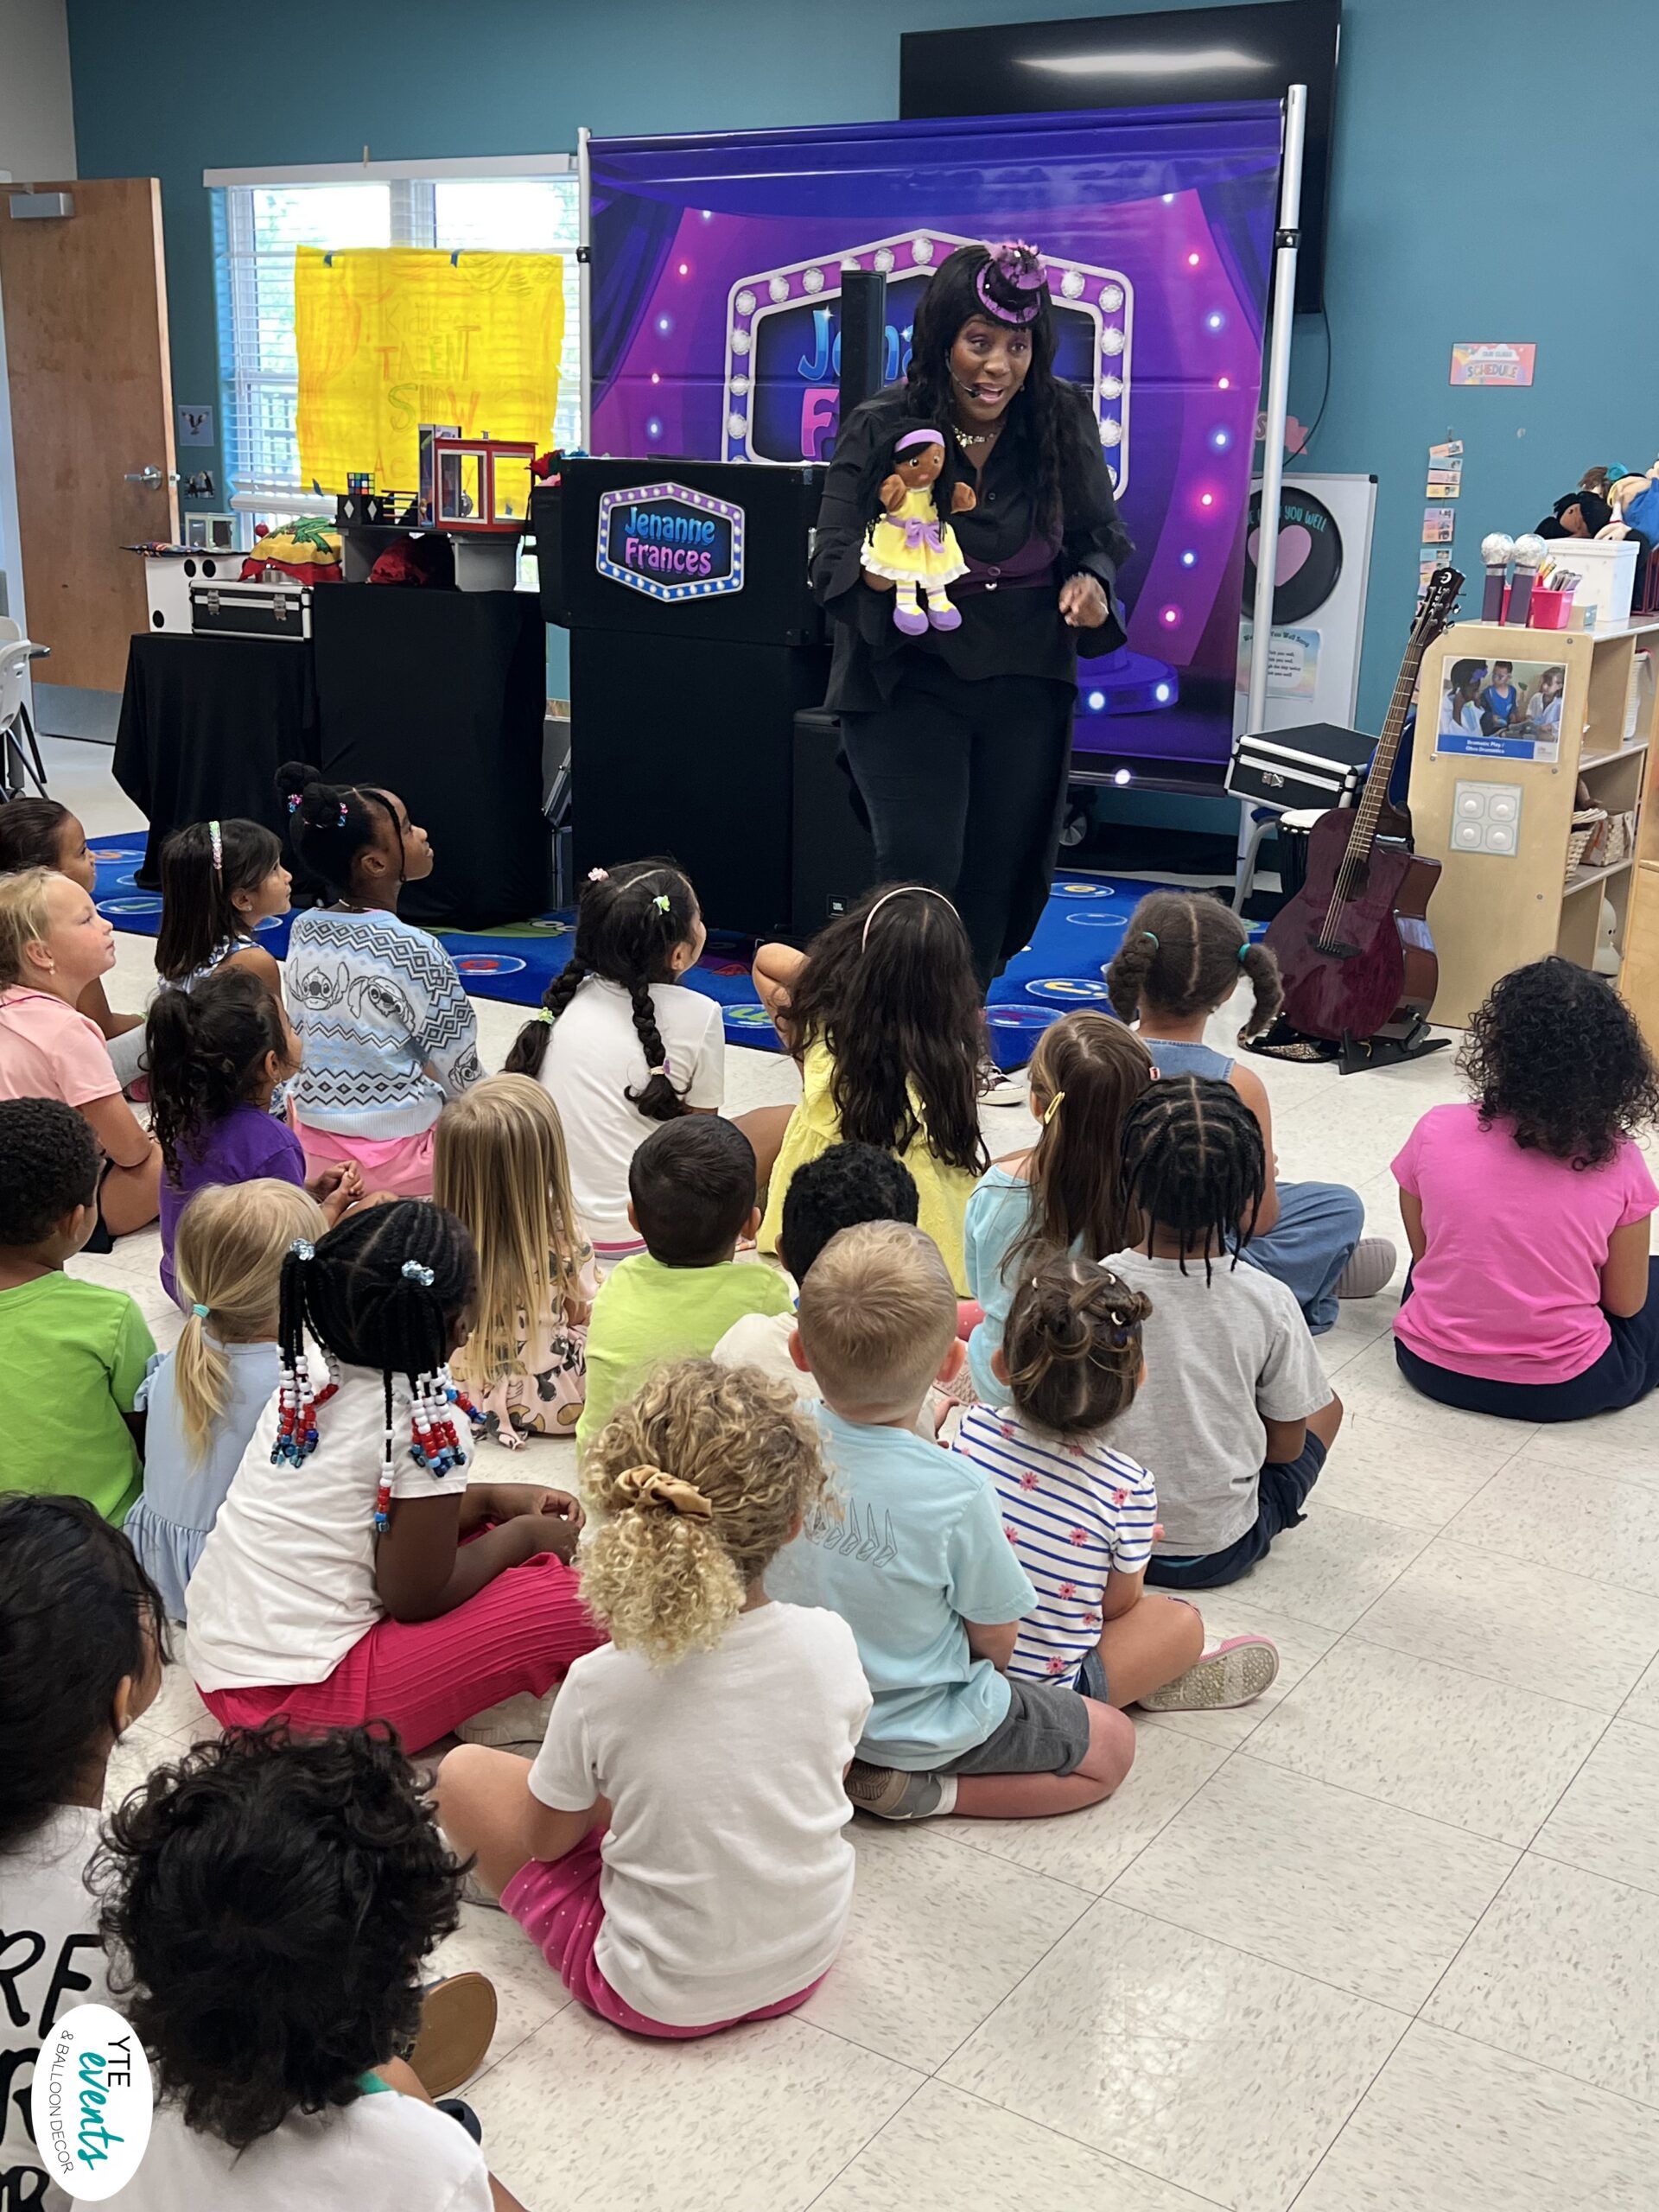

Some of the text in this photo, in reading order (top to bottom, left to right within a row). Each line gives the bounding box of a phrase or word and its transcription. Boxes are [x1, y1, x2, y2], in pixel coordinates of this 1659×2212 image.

[373, 325, 481, 381] TALENT
[1467, 364, 1518, 378] SCHEDULE
[388, 383, 480, 435] SHOW
[625, 506, 715, 545] Jenanne
[1305, 511, 1327, 532] WELL
[625, 537, 712, 576] Frances
